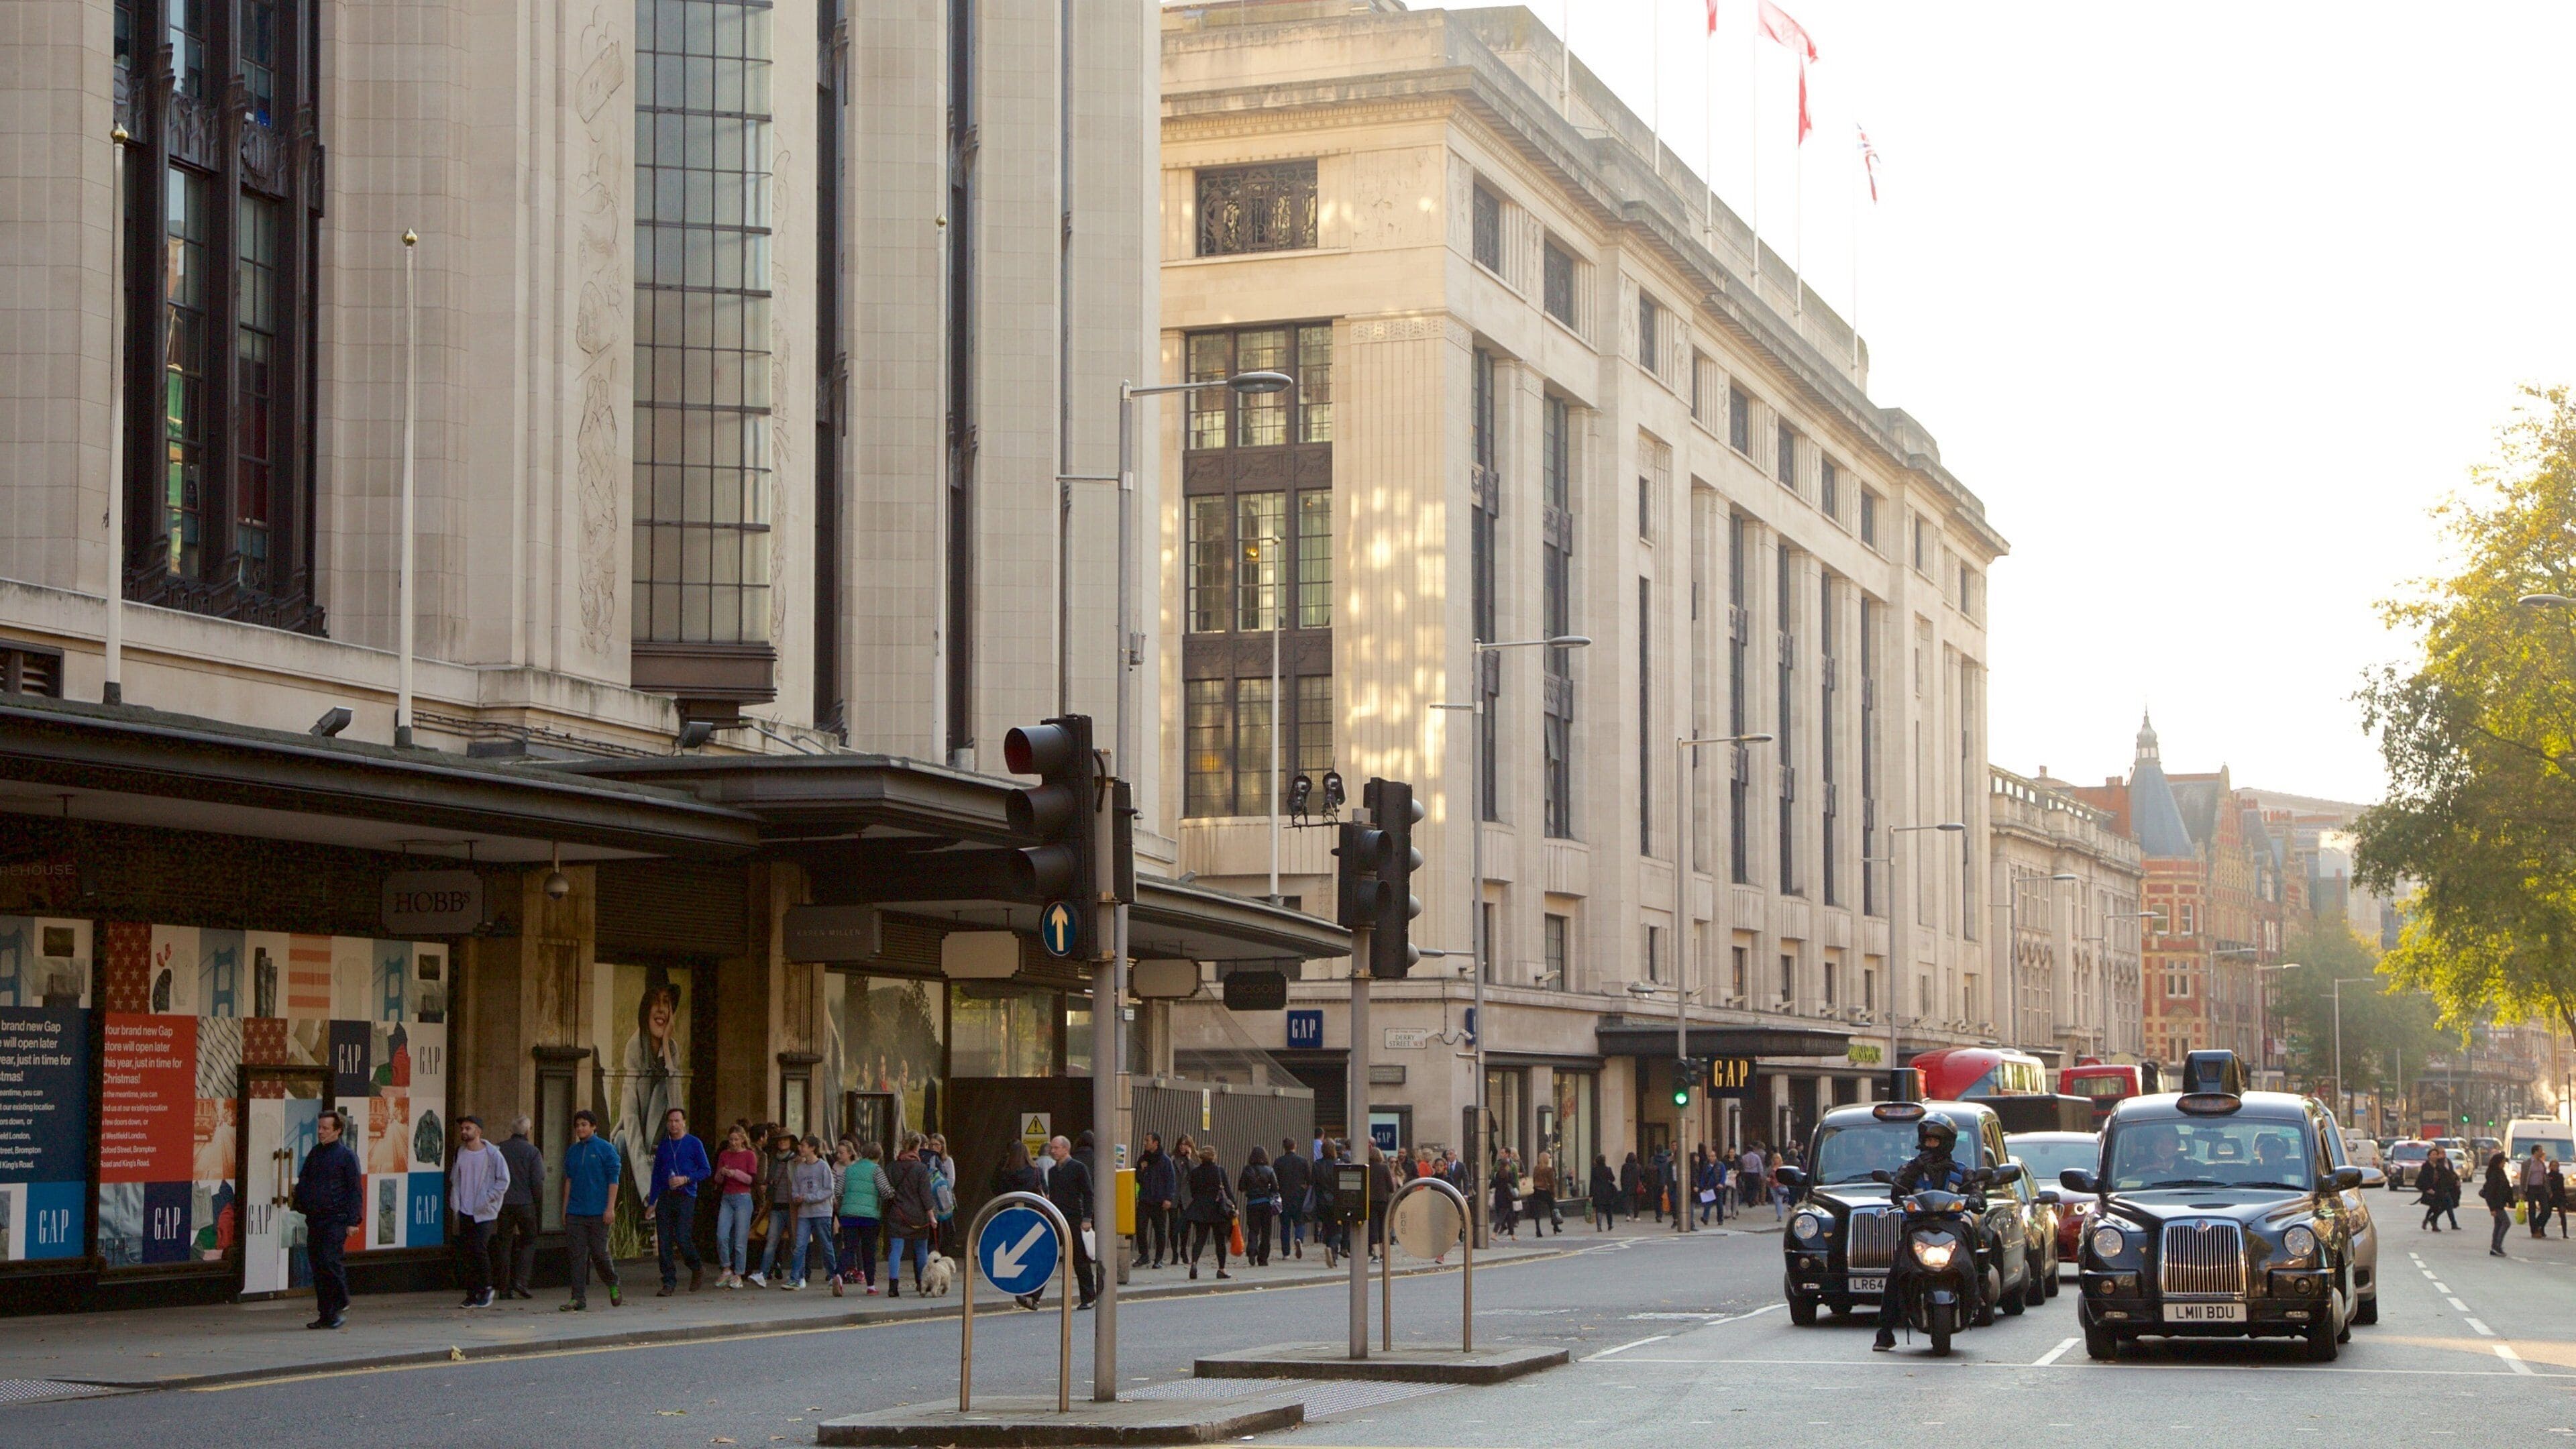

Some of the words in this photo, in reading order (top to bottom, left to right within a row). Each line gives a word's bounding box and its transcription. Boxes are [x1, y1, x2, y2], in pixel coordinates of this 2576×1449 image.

[1, 1020, 25, 1031] brand
[26, 1022, 43, 1031] new
[44, 1020, 61, 1034] Gap
[121, 1024, 142, 1036] brand
[143, 1026, 158, 1036] new
[158, 1025, 173, 1038] Gap
[1292, 1018, 1316, 1038] GAP
[3, 1036, 17, 1048] will
[17, 1039, 38, 1051] open
[40, 1038, 58, 1049] later
[123, 1040, 135, 1051] will
[135, 1042, 154, 1053] open
[154, 1041, 171, 1052] later
[16, 1054, 32, 1067] just
[33, 1055, 40, 1065] in
[42, 1055, 59, 1065] time
[60, 1055, 72, 1065] for
[117, 1059, 134, 1070] year,
[134, 1057, 148, 1070] just
[148, 1057, 156, 1068] in
[156, 1057, 172, 1068] time
[172, 1057, 182, 1068] for
[338, 1043, 361, 1074] GAP
[419, 1045, 441, 1075] GAP
[103, 1073, 141, 1084] Christmas!
[1714, 1060, 1748, 1087] GAP
[1377, 1132, 1391, 1143] GAP
[15, 1146, 42, 1155] Brompton
[133, 1145, 156, 1154] Brompton
[416, 1195, 437, 1224] GAP
[38, 1209, 69, 1244] GAP
[154, 1207, 180, 1240] GAP
[248, 1204, 272, 1235] GAP
[1854, 1279, 1884, 1290] LR64
[2206, 1306, 2235, 1319] BDU
